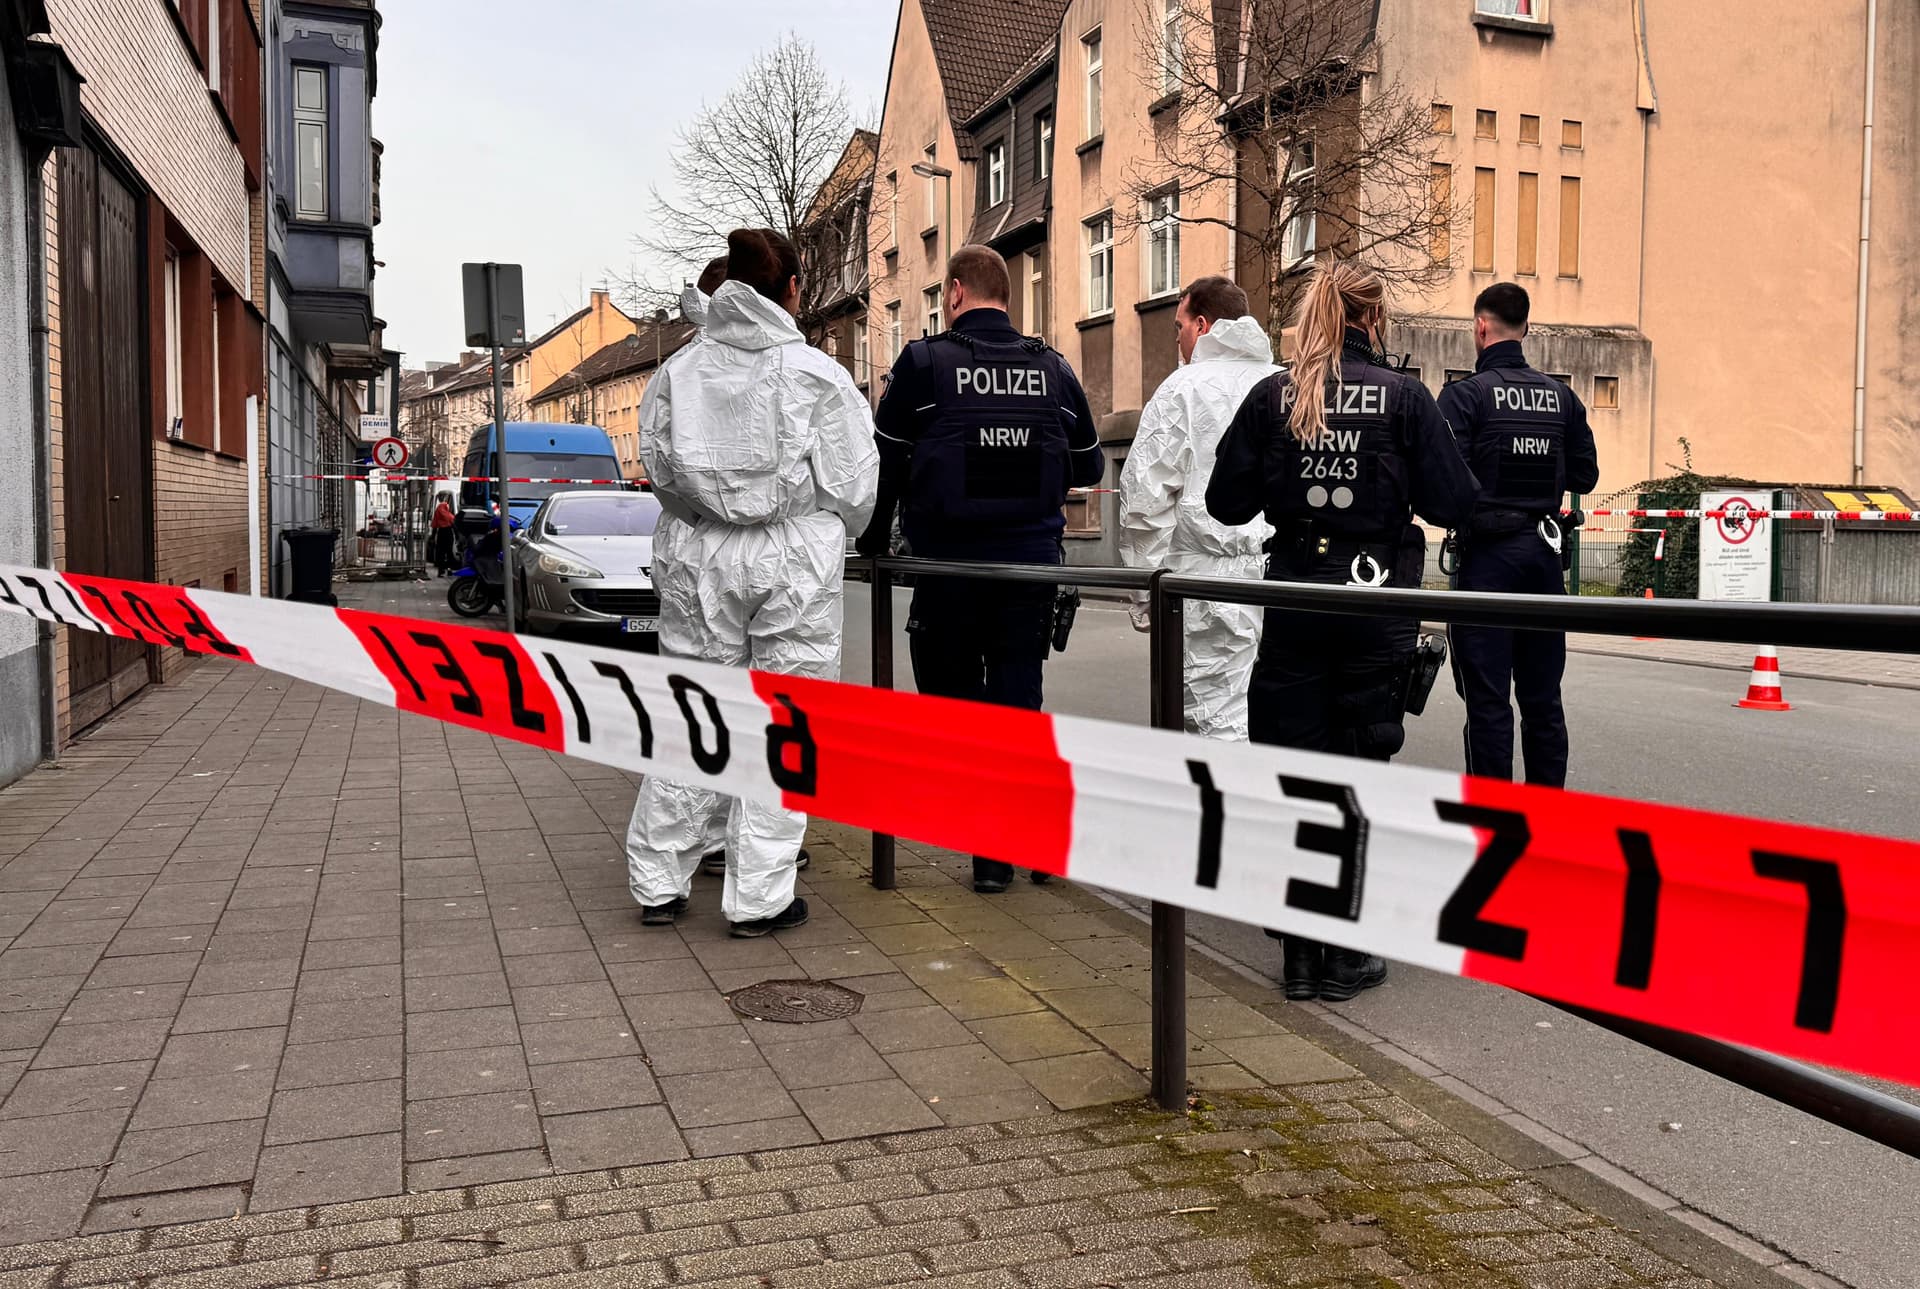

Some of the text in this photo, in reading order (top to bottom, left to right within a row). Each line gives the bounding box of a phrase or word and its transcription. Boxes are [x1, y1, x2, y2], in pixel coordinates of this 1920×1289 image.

[955, 367, 1047, 396] POLIZEI
[1280, 385, 1387, 414] PLIZEI
[1493, 386, 1561, 413] POLIZEI
[979, 428, 1030, 447] NRW
[1512, 437, 1550, 456] NRW
[1300, 456, 1358, 480] 2643
[630, 620, 653, 631] GSZ
[368, 625, 818, 797] POLIZEI
